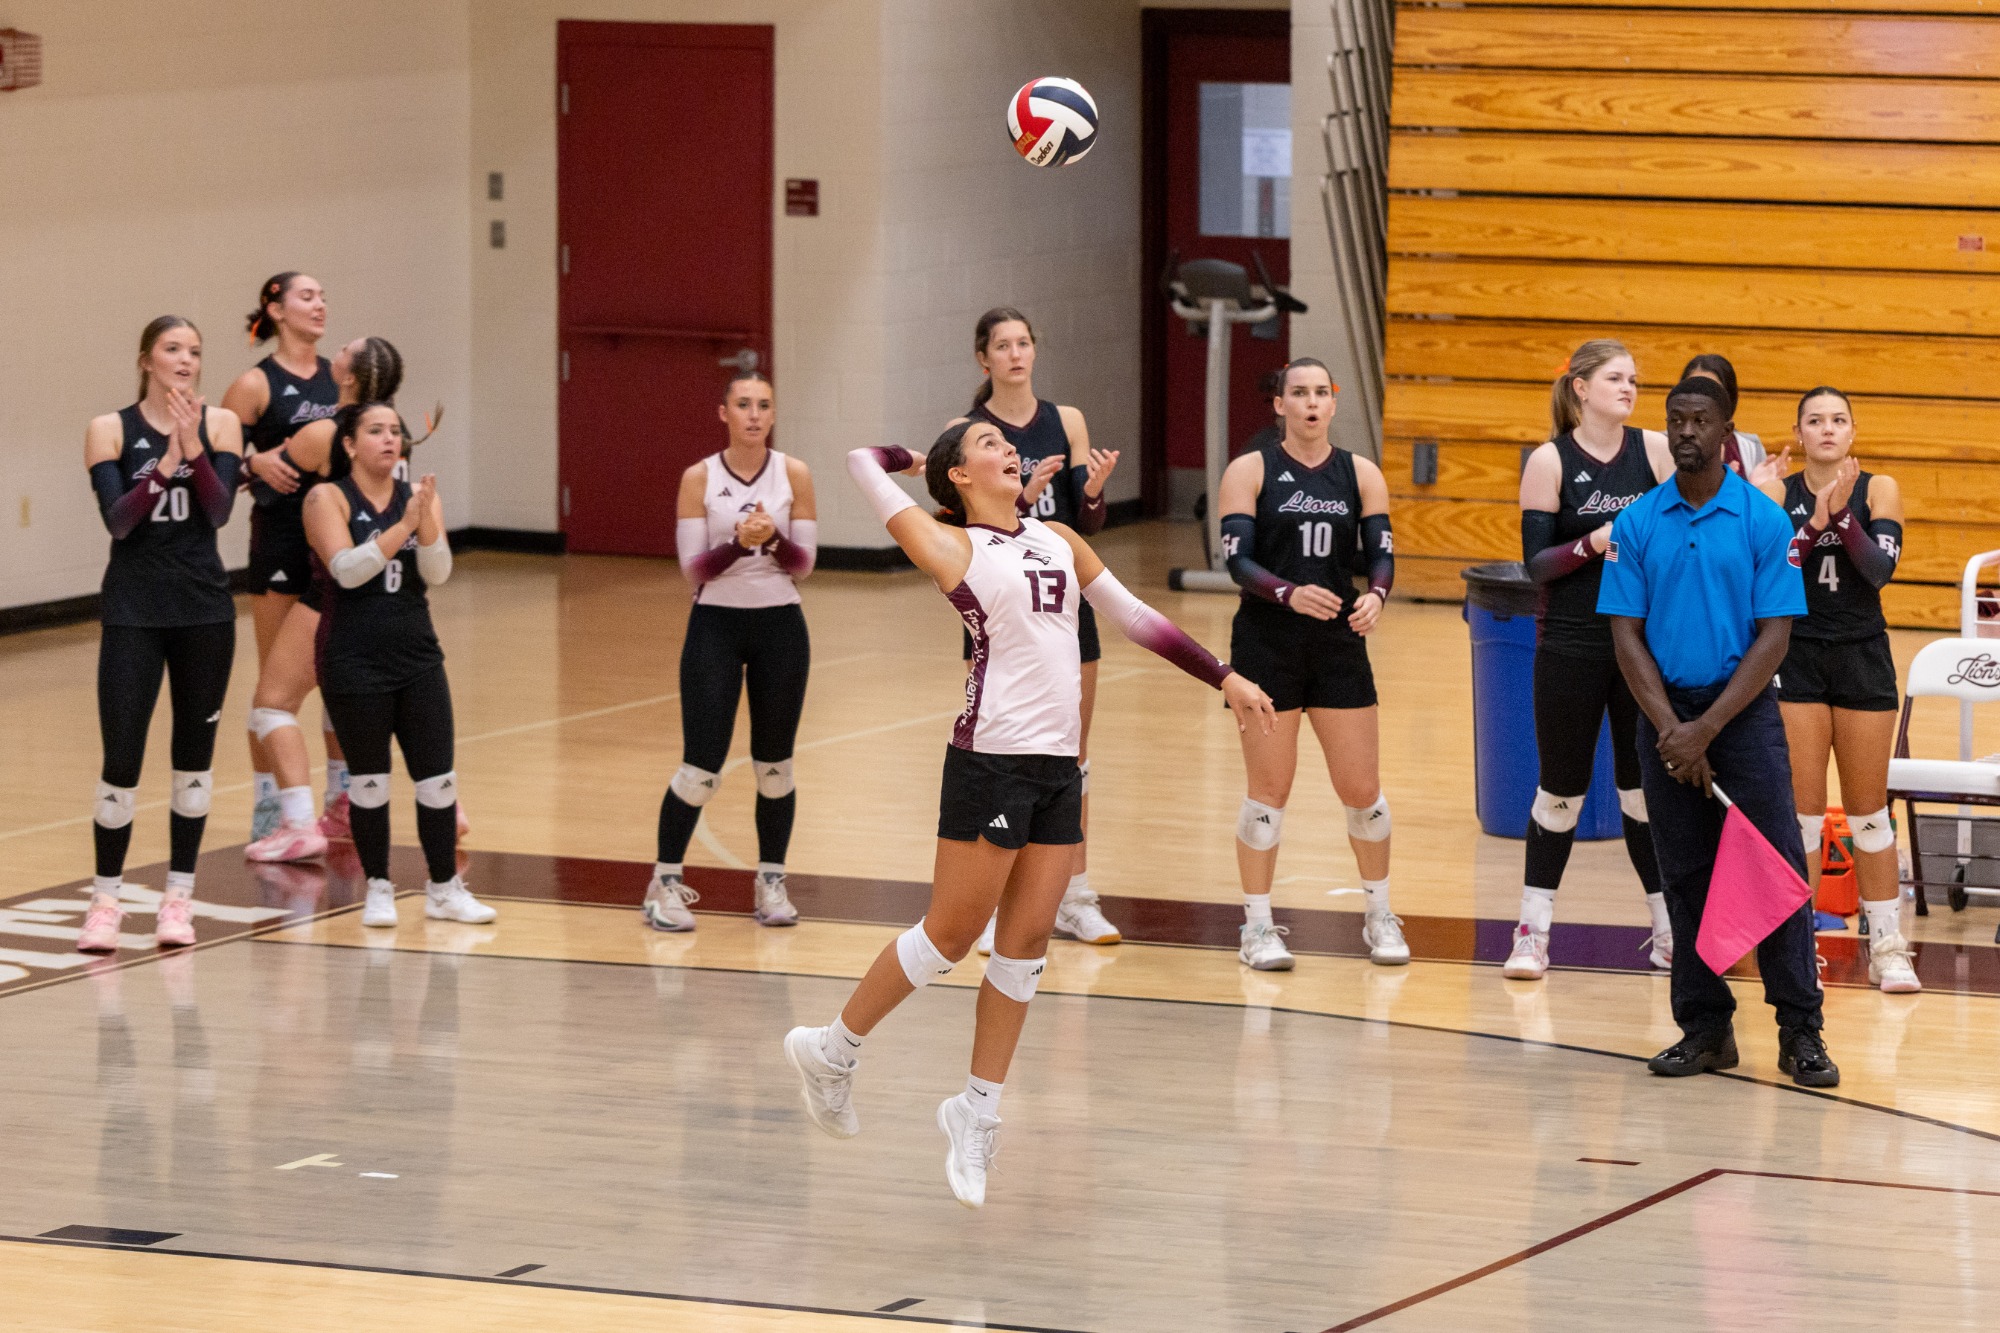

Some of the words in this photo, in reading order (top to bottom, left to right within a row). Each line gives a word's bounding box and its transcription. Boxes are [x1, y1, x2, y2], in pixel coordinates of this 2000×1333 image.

[151, 486, 190, 522] 20
[1278, 489, 1350, 515] Lions
[1576, 489, 1645, 517] Lion
[1298, 520, 1333, 558] 10
[384, 559, 403, 594] 6
[1023, 569, 1067, 613] 13
[1817, 555, 1840, 592] 4
